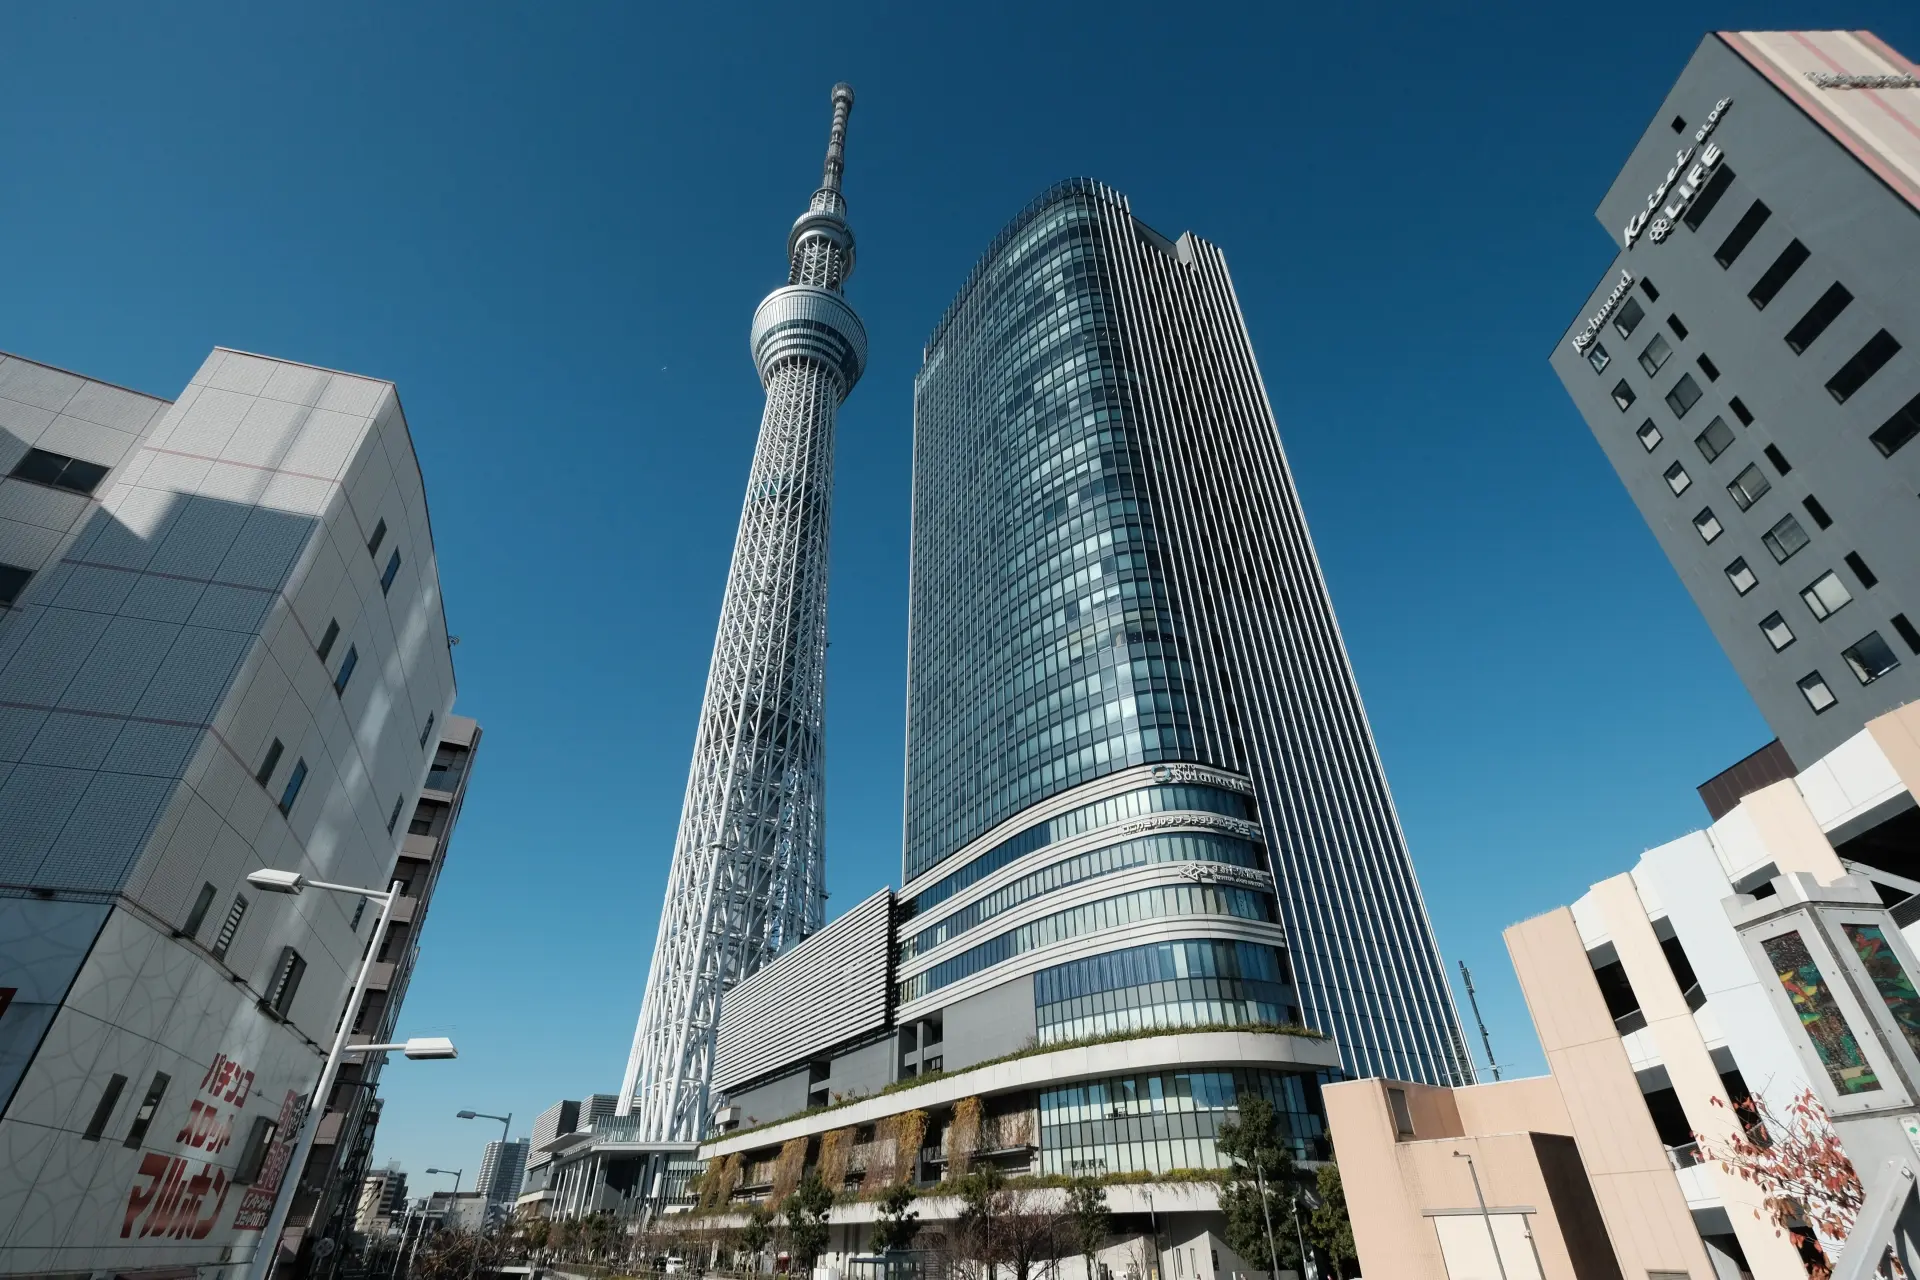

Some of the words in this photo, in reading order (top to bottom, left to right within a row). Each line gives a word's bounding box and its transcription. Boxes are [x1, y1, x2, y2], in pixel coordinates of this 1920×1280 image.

[1624, 148, 1692, 247] Keisei
[1665, 143, 1721, 219] LIFE
[1572, 269, 1631, 353] Richmond
[201, 1053, 255, 1108] パチンコ
[176, 1099, 234, 1153] スロット
[120, 1152, 231, 1240] マルホン
